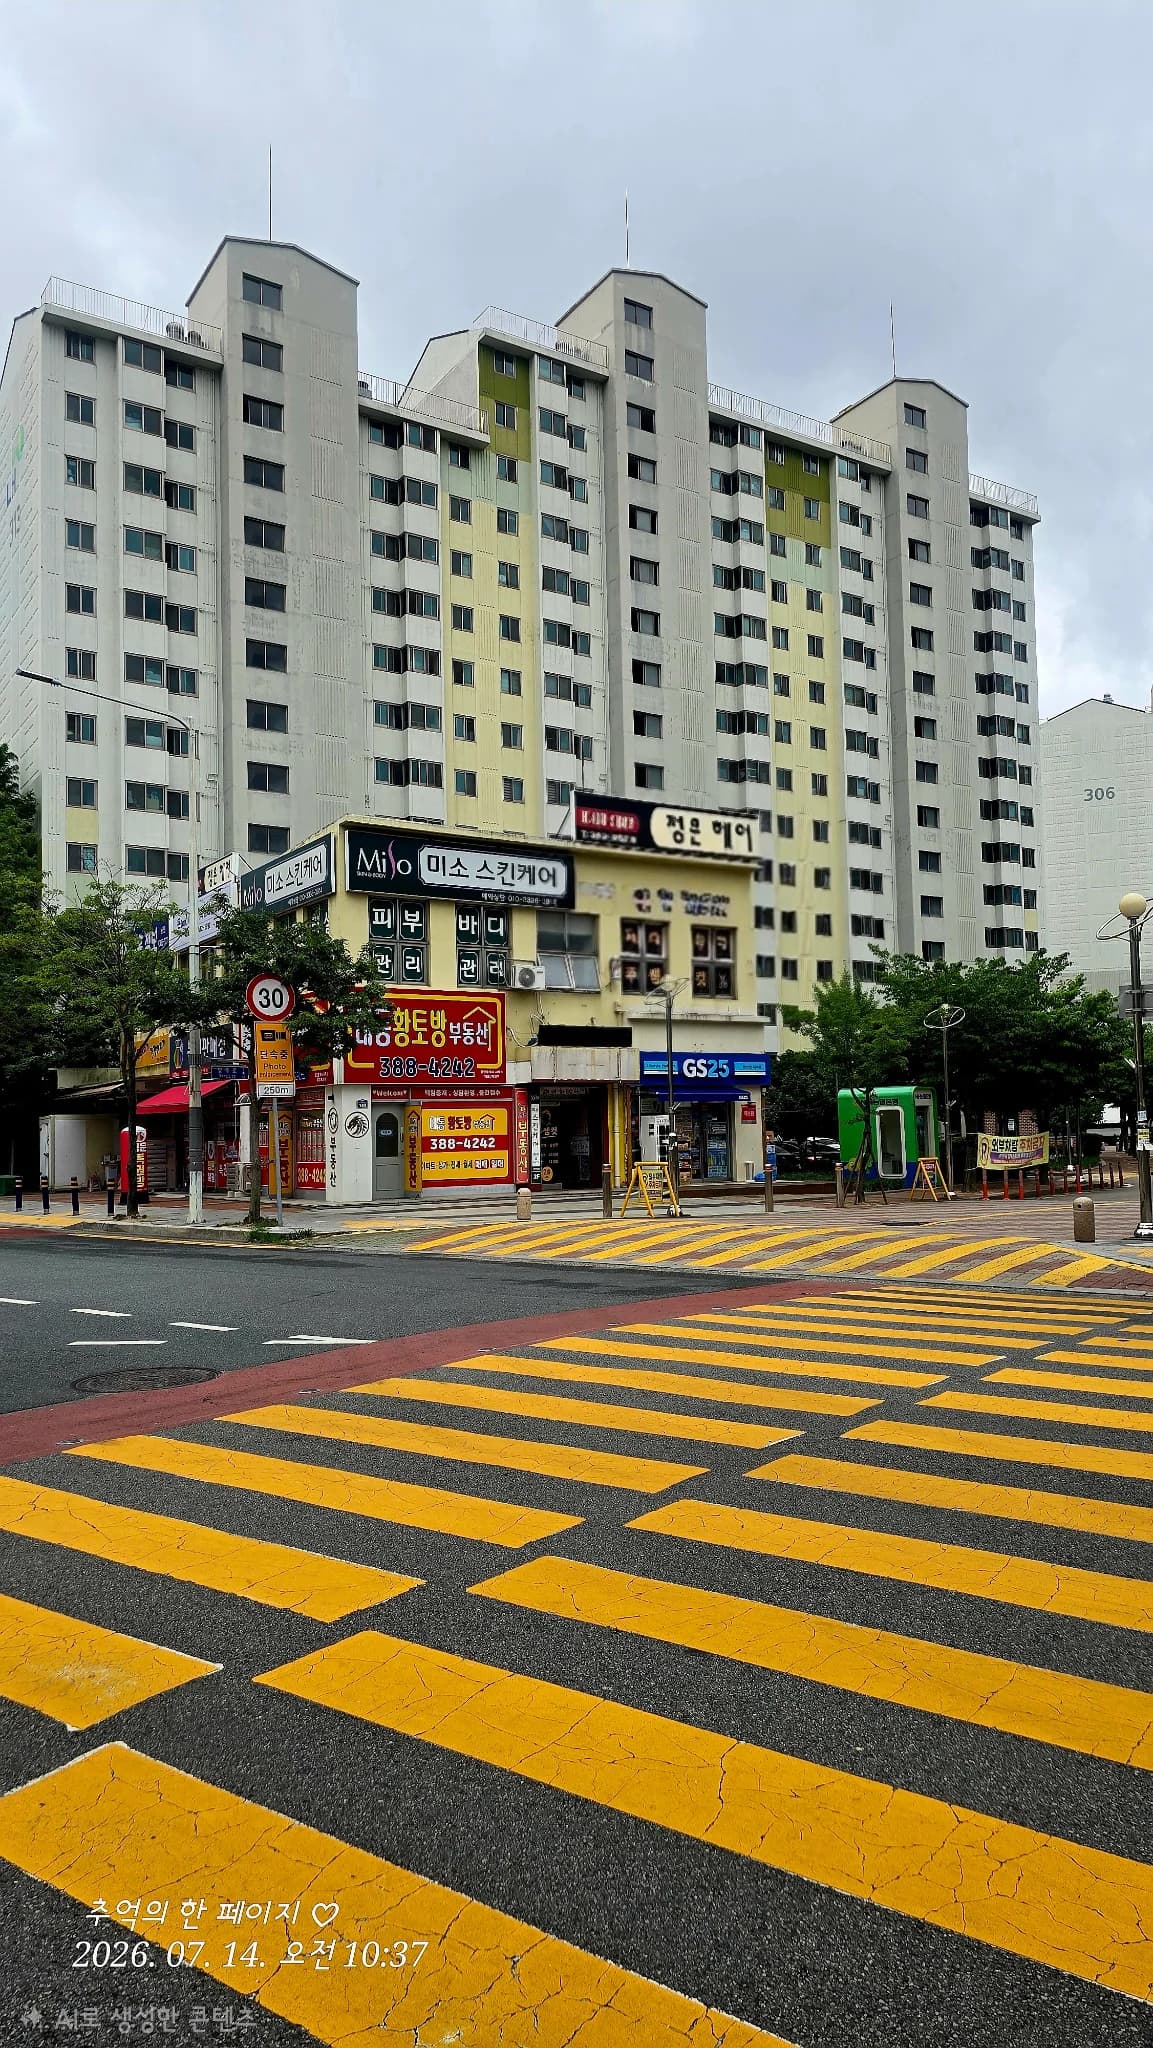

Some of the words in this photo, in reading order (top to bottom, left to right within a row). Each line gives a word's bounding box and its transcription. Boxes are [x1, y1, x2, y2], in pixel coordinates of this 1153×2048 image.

[1084, 786, 1115, 802] 306
[267, 871, 284, 894] 미소
[285, 851, 322, 887] 스킨케어
[427, 854, 470, 878] 미소
[476, 859, 557, 888] 스킨케어
[258, 987, 284, 1010] 30
[393, 1006, 448, 1048] 황토방
[449, 1021, 490, 1046] 부동산
[260, 1049, 289, 1060] 단속중
[379, 1056, 476, 1079] 388-4242
[682, 1058, 730, 1078] GS25
[263, 1086, 289, 1095] 250m
[429, 1137, 496, 1150] 388-4242
[518, 1121, 528, 1173] 부동산
